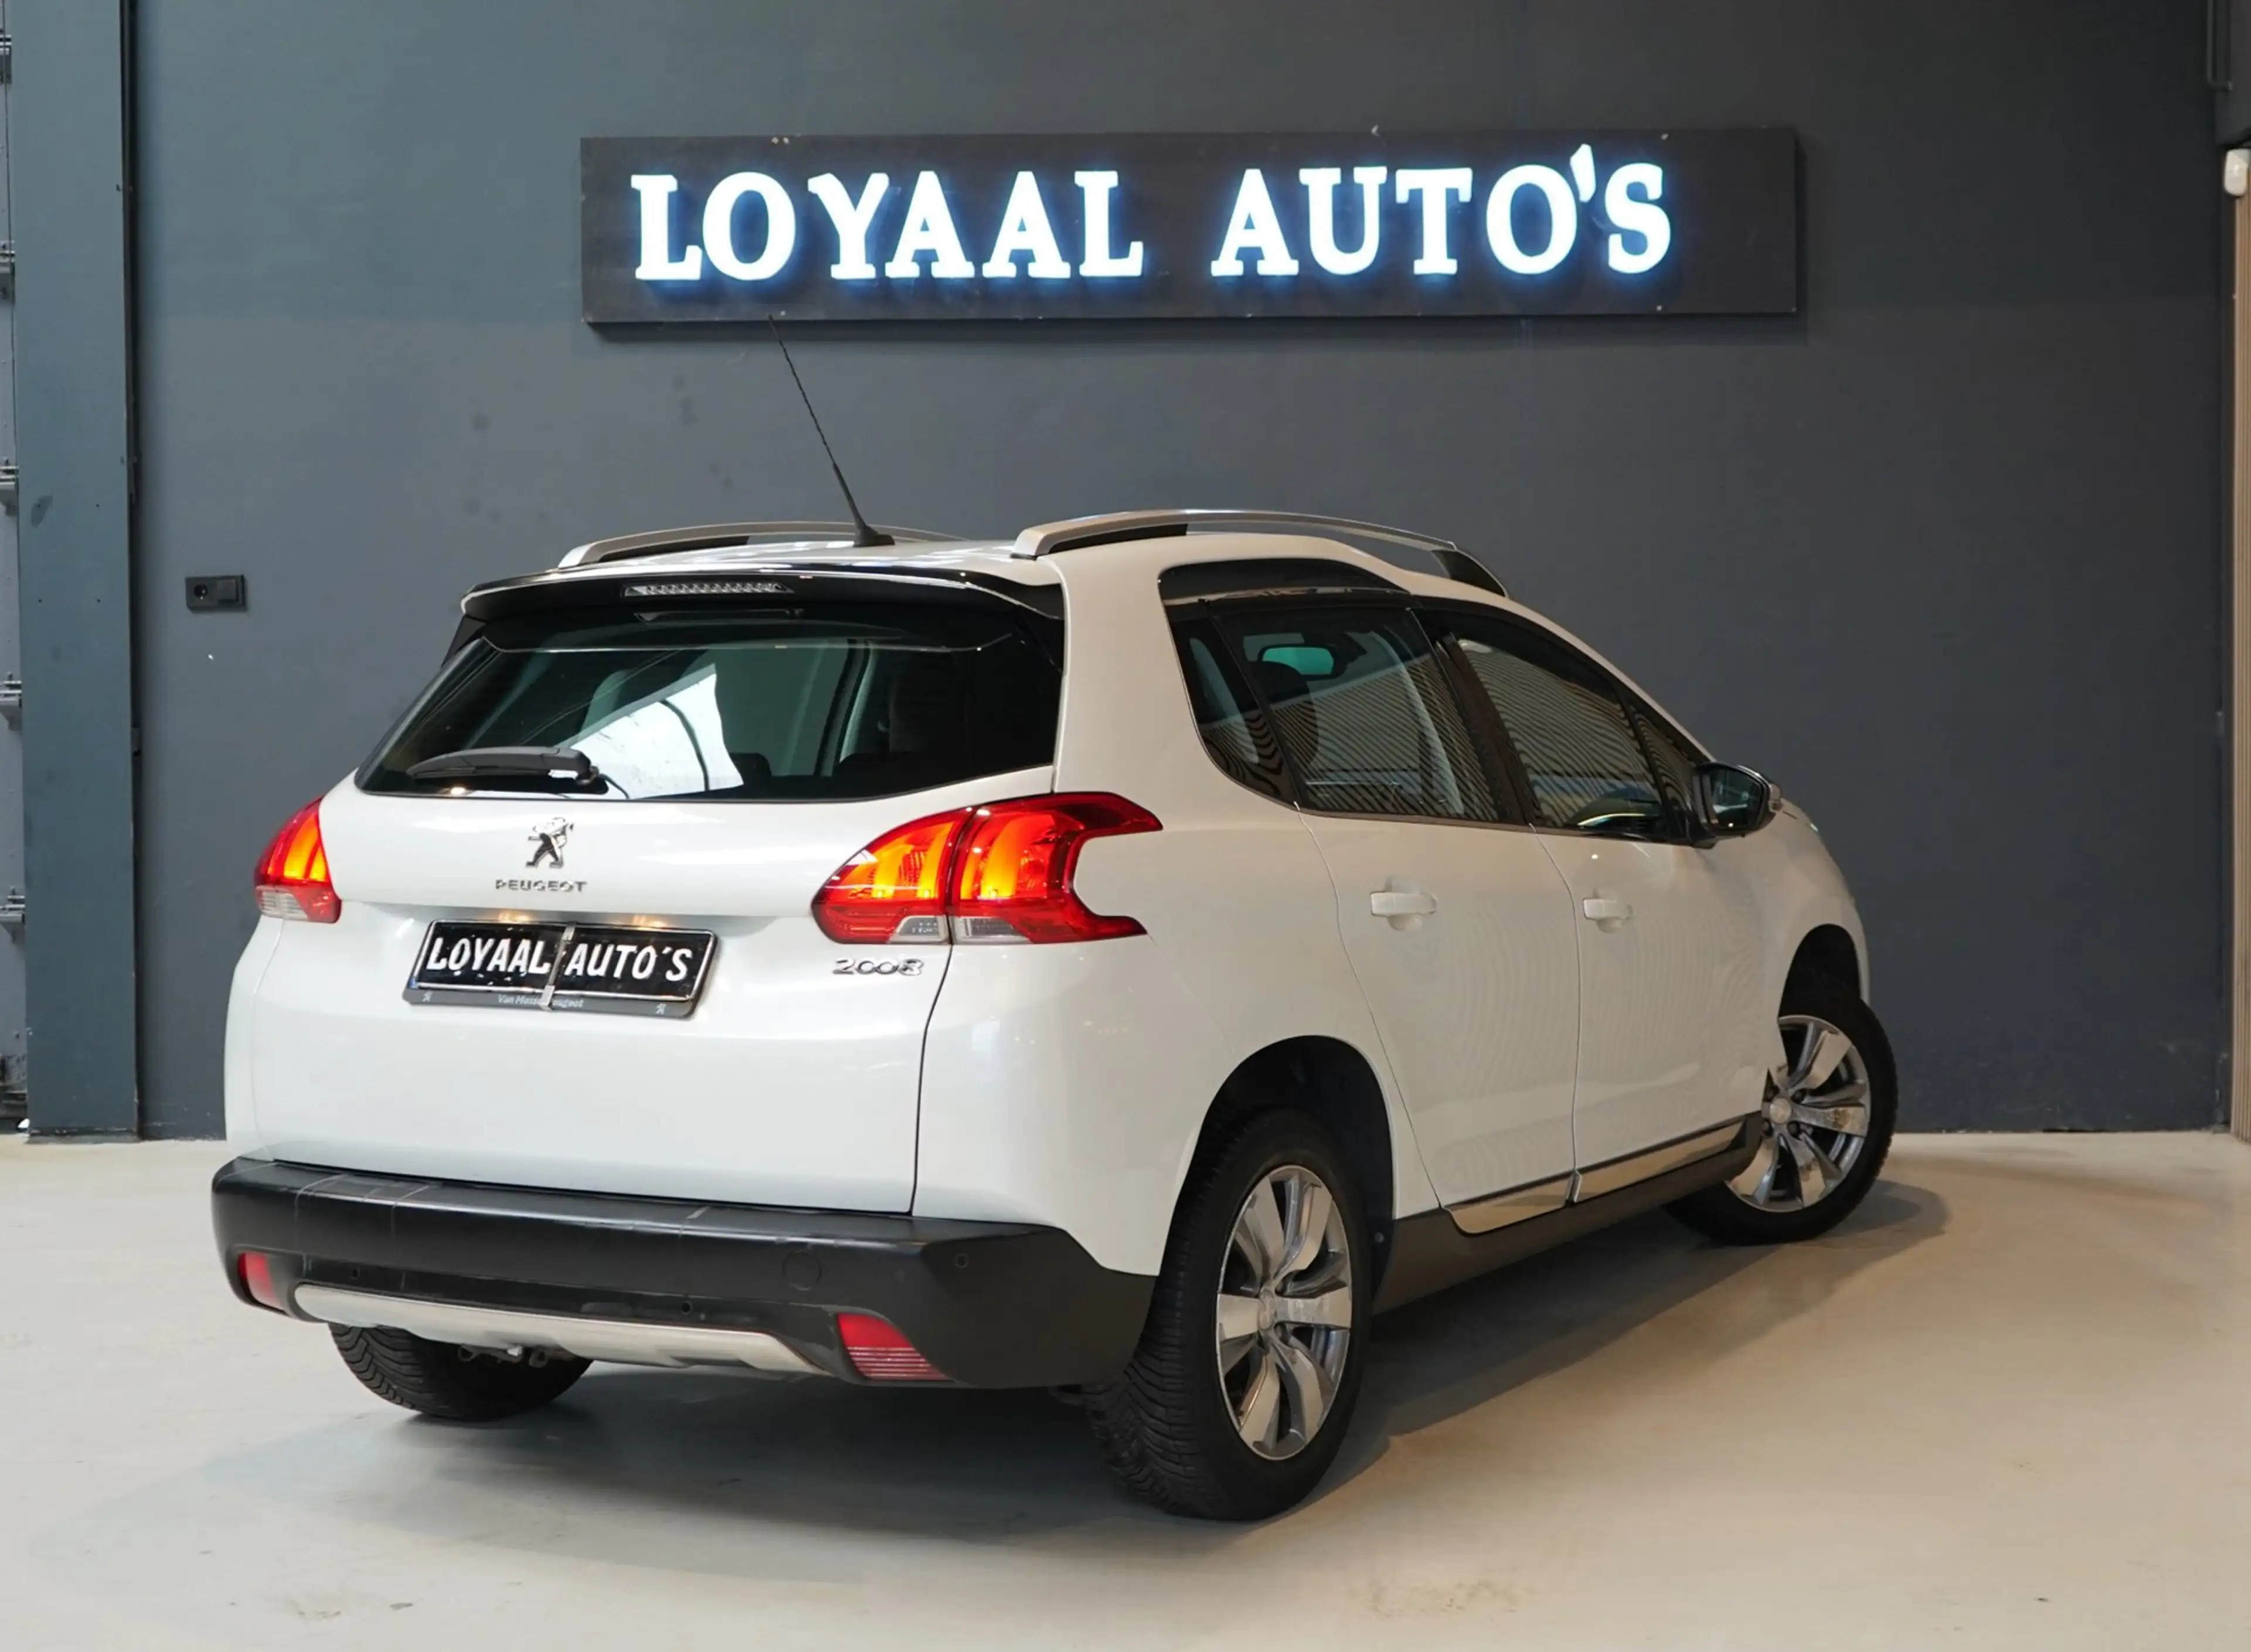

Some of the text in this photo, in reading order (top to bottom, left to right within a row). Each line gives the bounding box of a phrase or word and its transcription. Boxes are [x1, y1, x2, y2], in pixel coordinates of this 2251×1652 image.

[631, 144, 1671, 281] LOYAAL AUTO'S
[495, 879, 587, 892] PEUGEOT
[426, 937, 693, 982] LOYAAL AUTO'S
[832, 958, 924, 977] 2008
[498, 994, 514, 1004] Van
[549, 998, 584, 1009] eugeot
